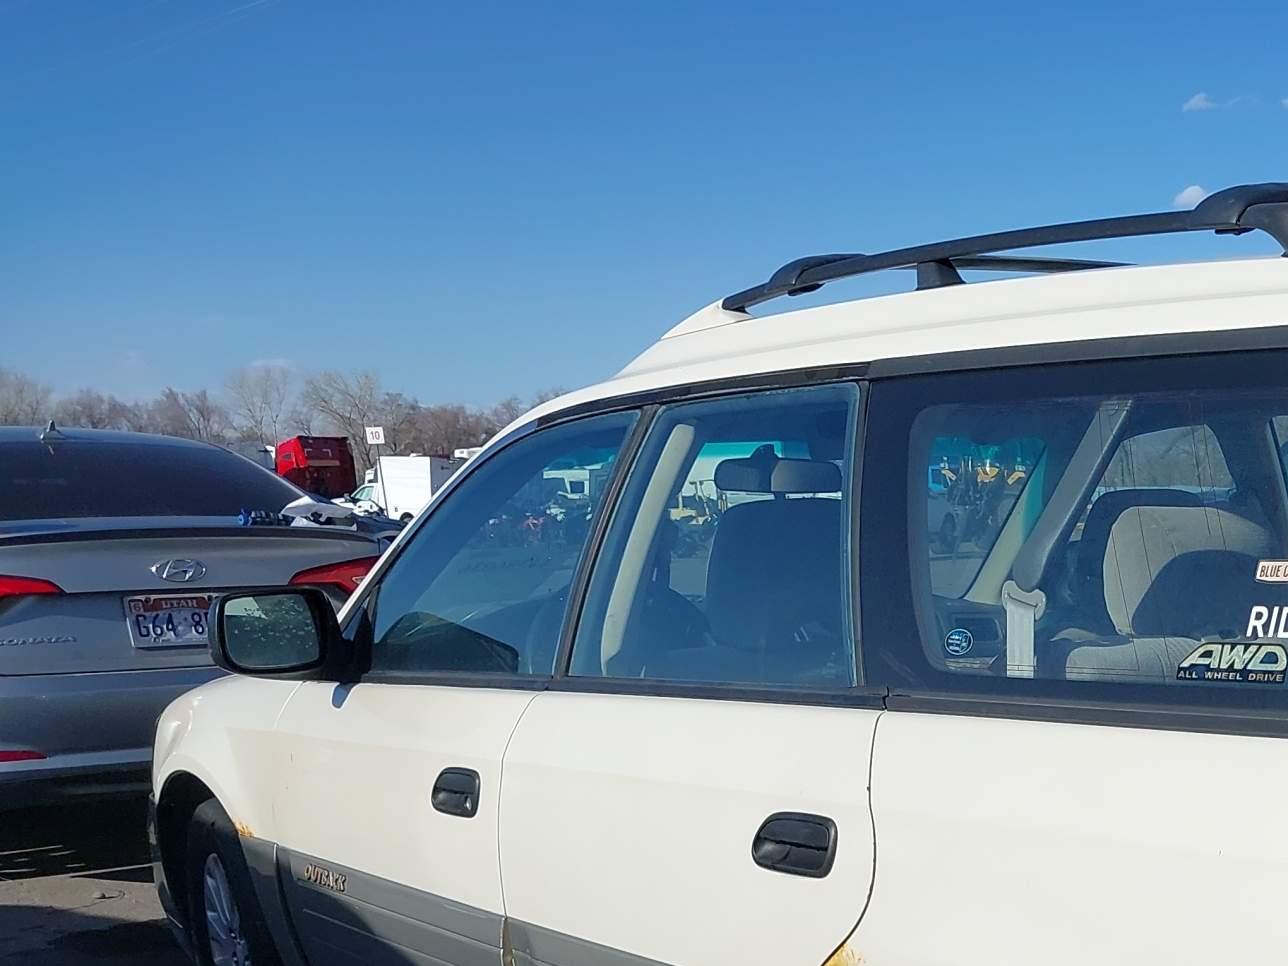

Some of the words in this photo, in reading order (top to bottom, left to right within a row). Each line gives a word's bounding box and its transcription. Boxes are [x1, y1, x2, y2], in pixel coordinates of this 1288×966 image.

[370, 431, 381, 441] 10
[1260, 565, 1281, 578] BLUE
[162, 599, 198, 609] UTAH
[1180, 643, 1288, 671] AWD
[1178, 670, 1199, 679] ALL
[1204, 671, 1243, 680] WHEEL
[1248, 672, 1284, 682] DRIVE
